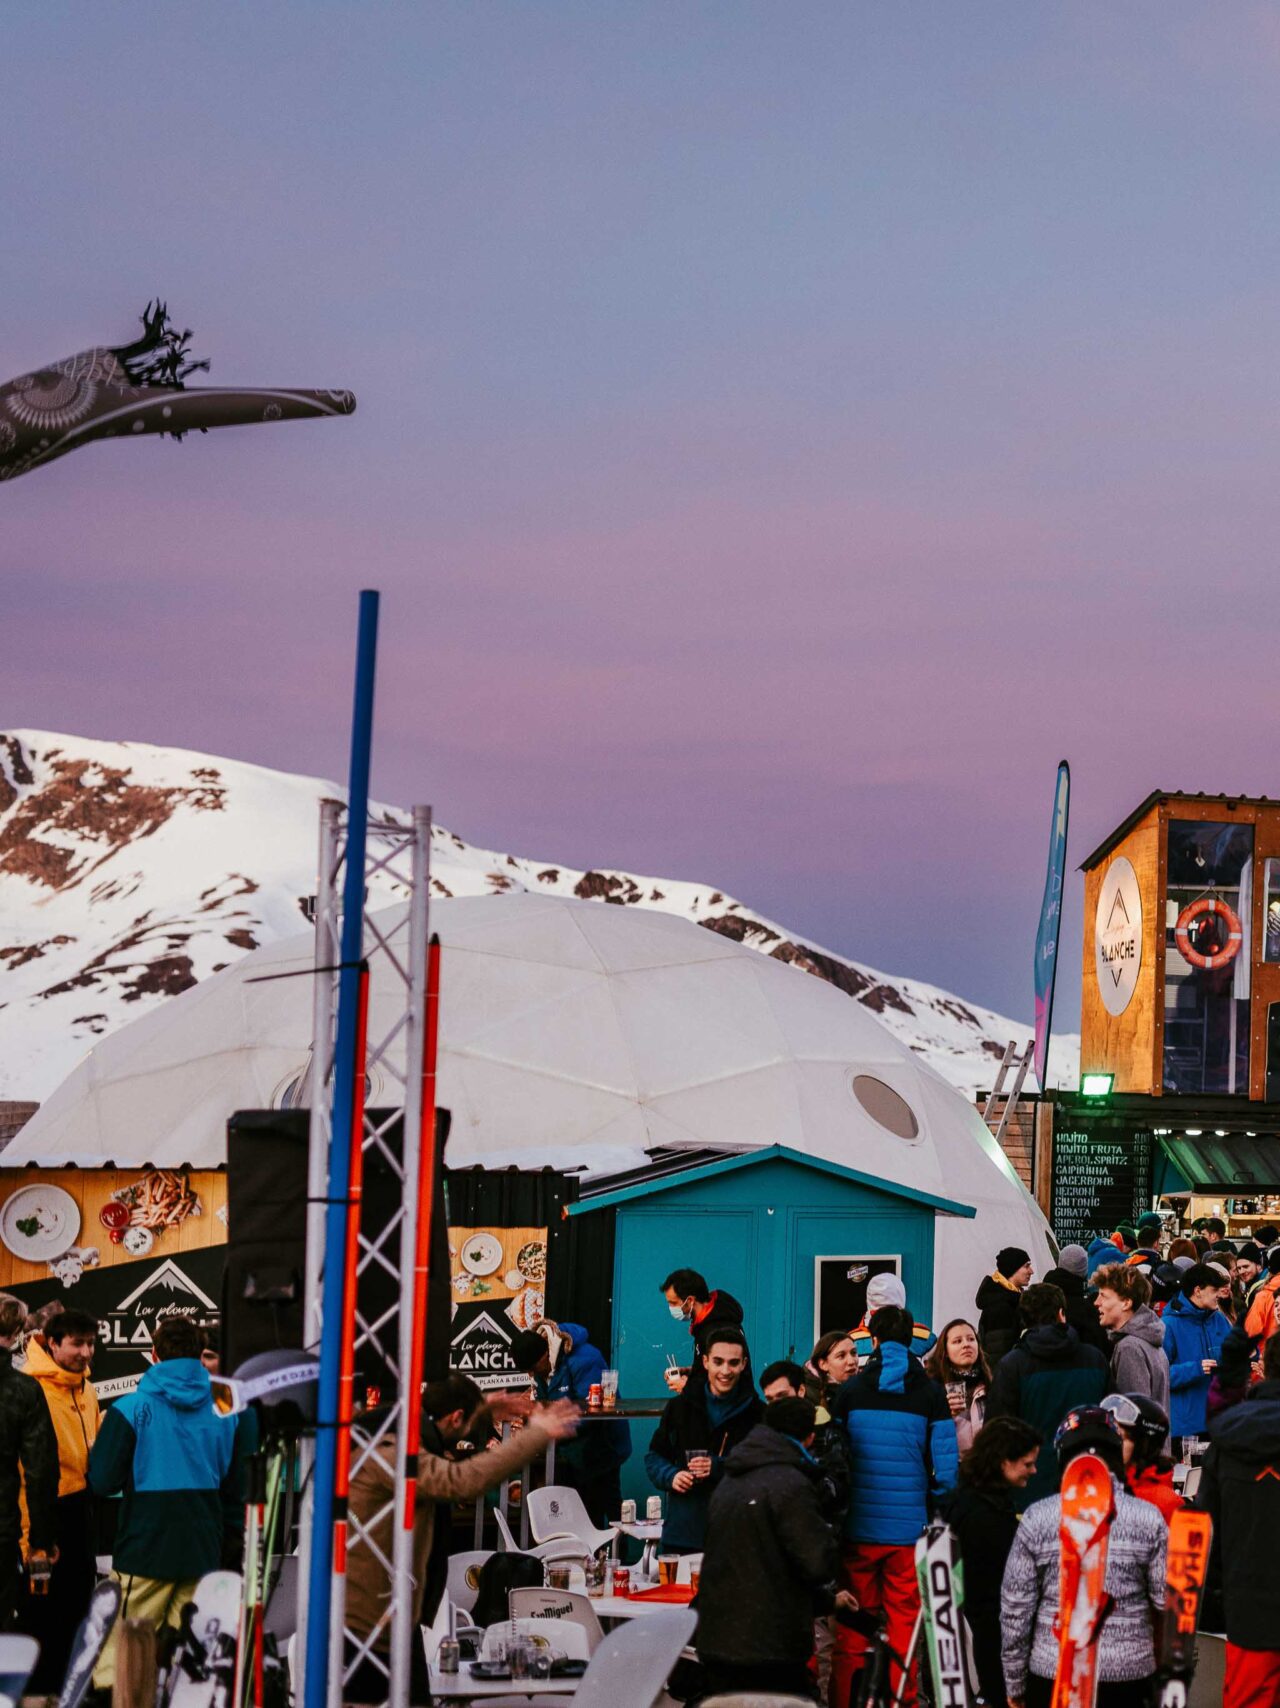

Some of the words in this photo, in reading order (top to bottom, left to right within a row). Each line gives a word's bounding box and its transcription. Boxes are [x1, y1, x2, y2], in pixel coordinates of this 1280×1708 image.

[1101, 939, 1135, 963] BLANCHE
[1090, 1145, 1123, 1155] FRUTA
[1054, 1218, 1084, 1228] SHOTS
[135, 1301, 155, 1317] La
[155, 1302, 199, 1320] plage
[449, 1352, 516, 1369] LANCH
[103, 1379, 138, 1392] SALUD
[1177, 1530, 1203, 1634] SHAPE
[930, 1560, 964, 1708] HEAD
